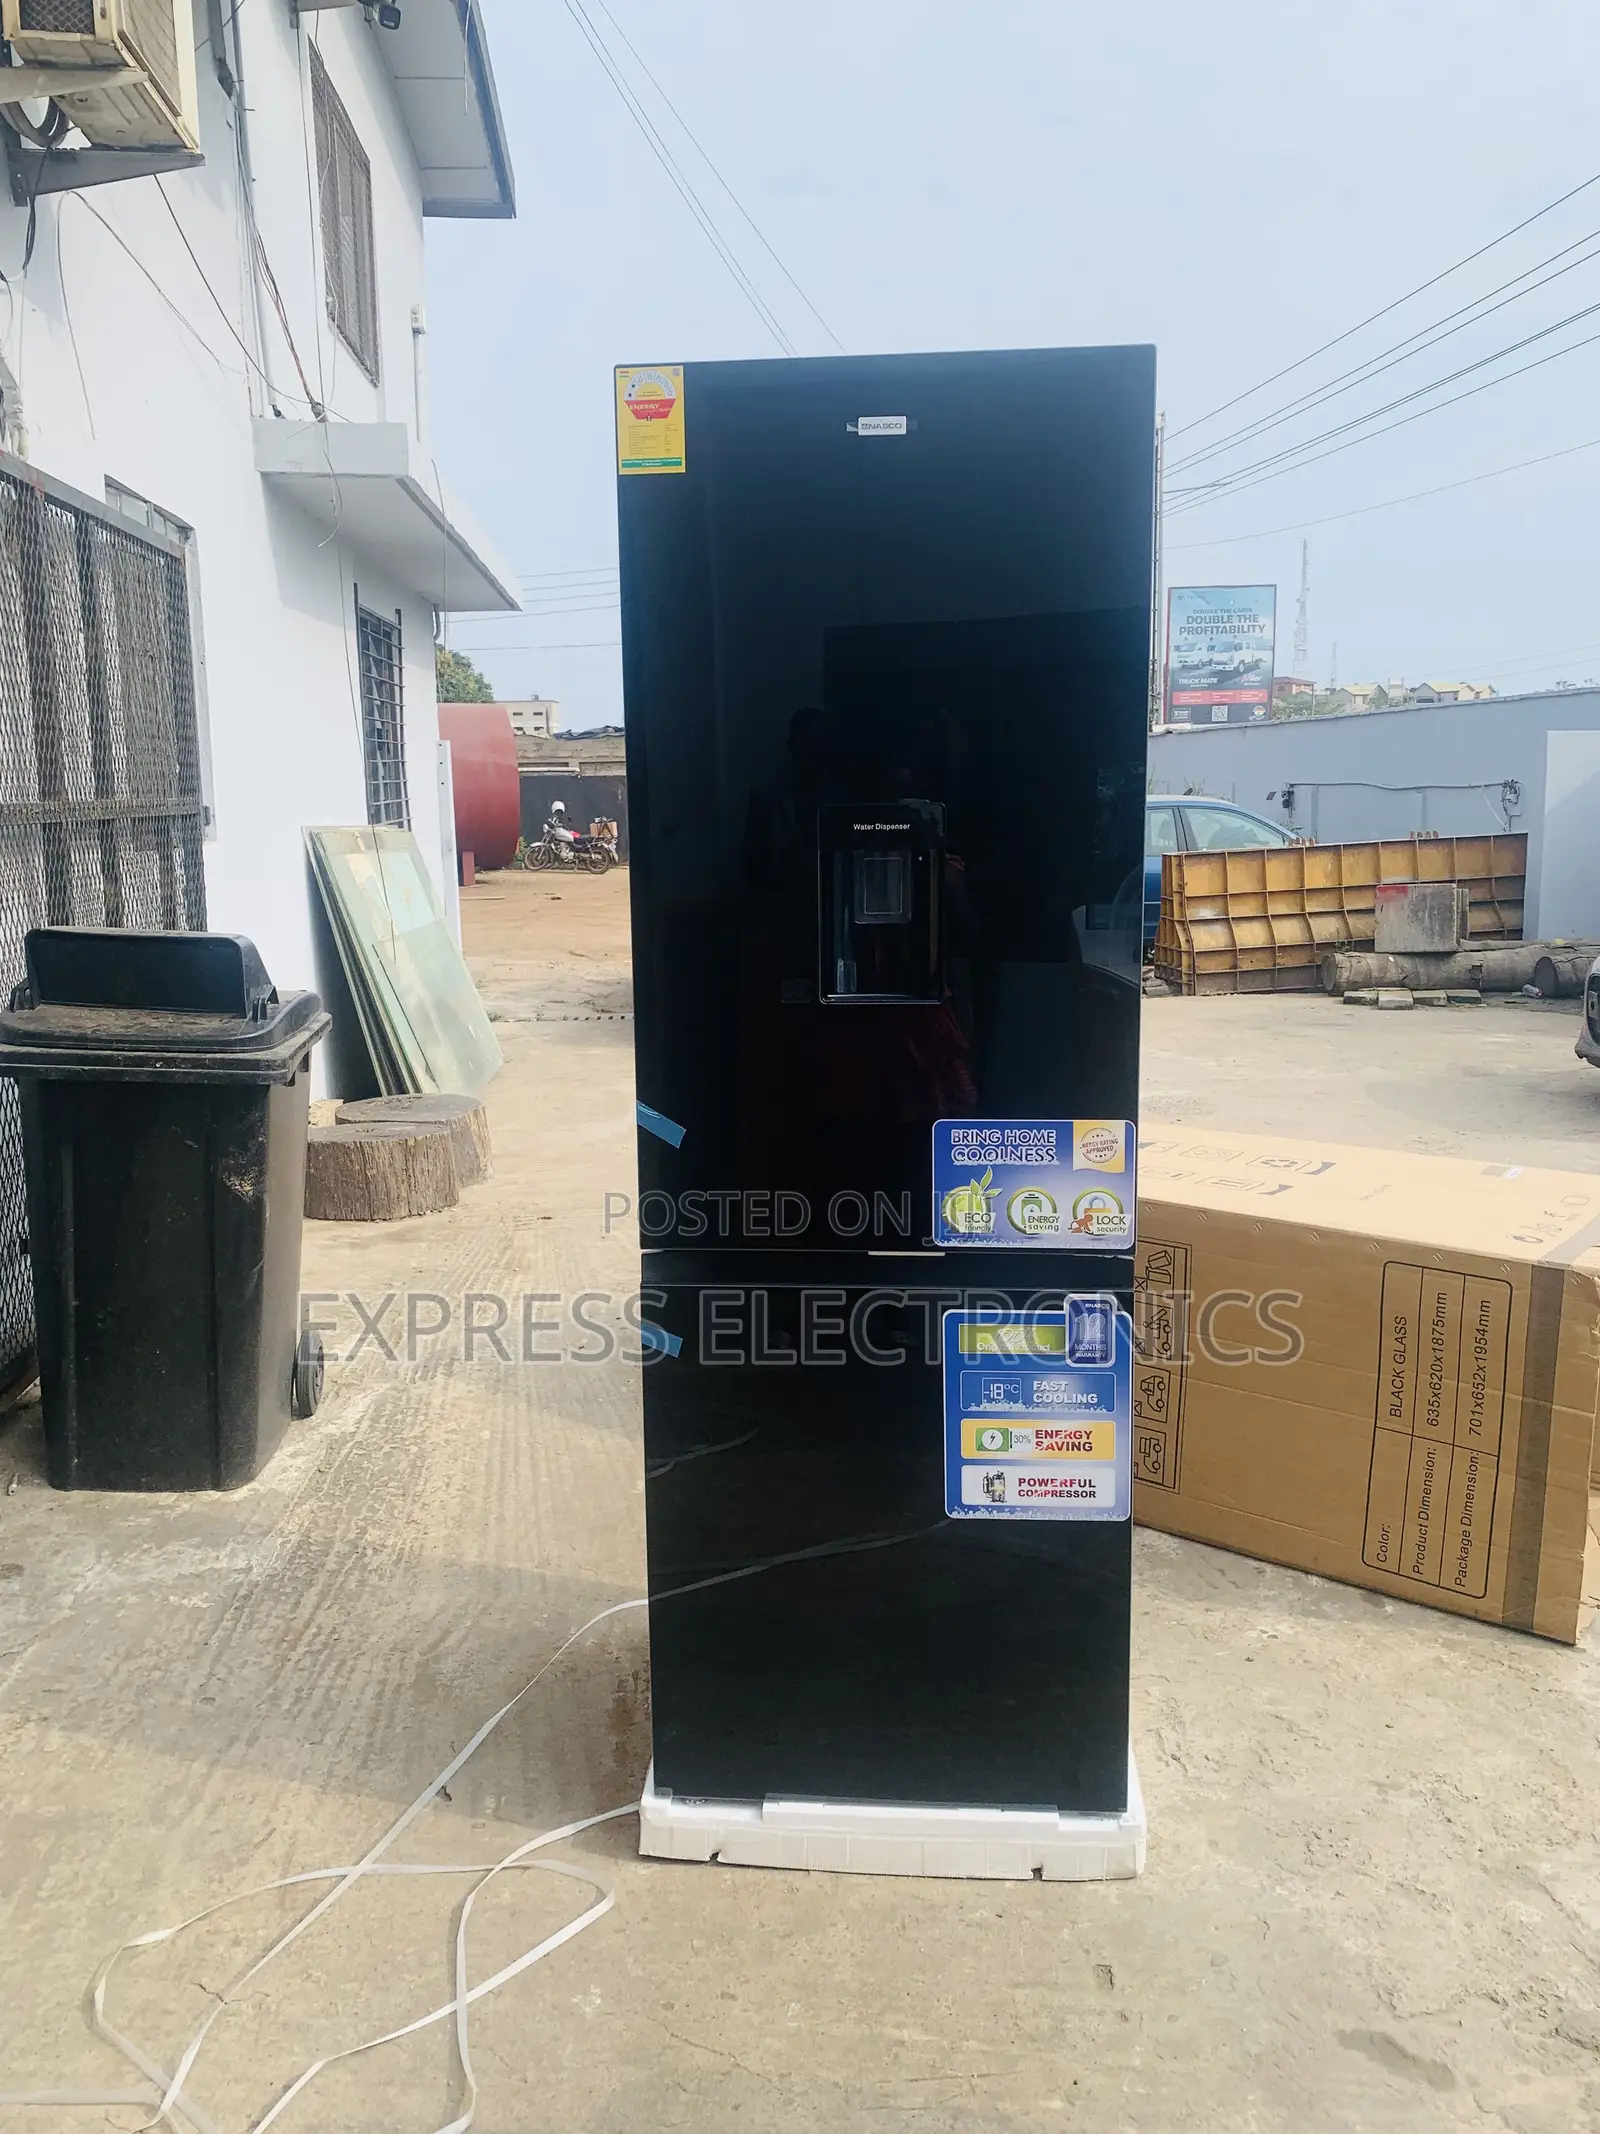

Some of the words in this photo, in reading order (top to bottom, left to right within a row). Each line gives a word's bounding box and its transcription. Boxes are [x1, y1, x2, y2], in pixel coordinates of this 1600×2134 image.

[1186, 615, 1234, 625] DOUBLE
[1236, 614, 1259, 624] THE
[1179, 624, 1266, 636] PROFITABILITY
[1178, 678, 1200, 686] TRUCK
[853, 823, 874, 831] Water
[875, 823, 910, 832] Dispenser
[952, 1129, 1002, 1145] BRING
[1004, 1129, 1057, 1145] HOME
[952, 1146, 1057, 1163] COOLNESS
[1086, 1144, 1115, 1155] APPROVED
[964, 1212, 992, 1224] ECO
[1027, 1215, 1061, 1224] ENERGY
[1096, 1215, 1127, 1225] LOCK
[1028, 1223, 1060, 1232] saving
[1097, 1225, 1127, 1234] security
[1074, 1312, 1106, 1341] 12
[1393, 1315, 1408, 1365] GLASS
[1074, 1343, 1107, 1351] MONTHS
[1426, 1291, 1448, 1427] 635x620x1875mm
[1468, 1299, 1492, 1437] 701x652x1954mm
[1032, 1380, 1068, 1392] FAST
[1032, 1393, 1098, 1404] COOLING
[1389, 1368, 1406, 1418] BLACK
[1013, 1434, 1032, 1444] 30%
[1035, 1429, 1093, 1440] ENERGY
[1035, 1441, 1093, 1452] SAVING
[1017, 1477, 1097, 1488] POWERFUL
[1417, 1446, 1437, 1522] Dimension:
[1017, 1489, 1097, 1499] COMPRESSOR
[1460, 1451, 1480, 1528] Dimension:
[1376, 1523, 1391, 1563] Color:
[1412, 1523, 1429, 1576] Product
[1454, 1529, 1473, 1588] Package
